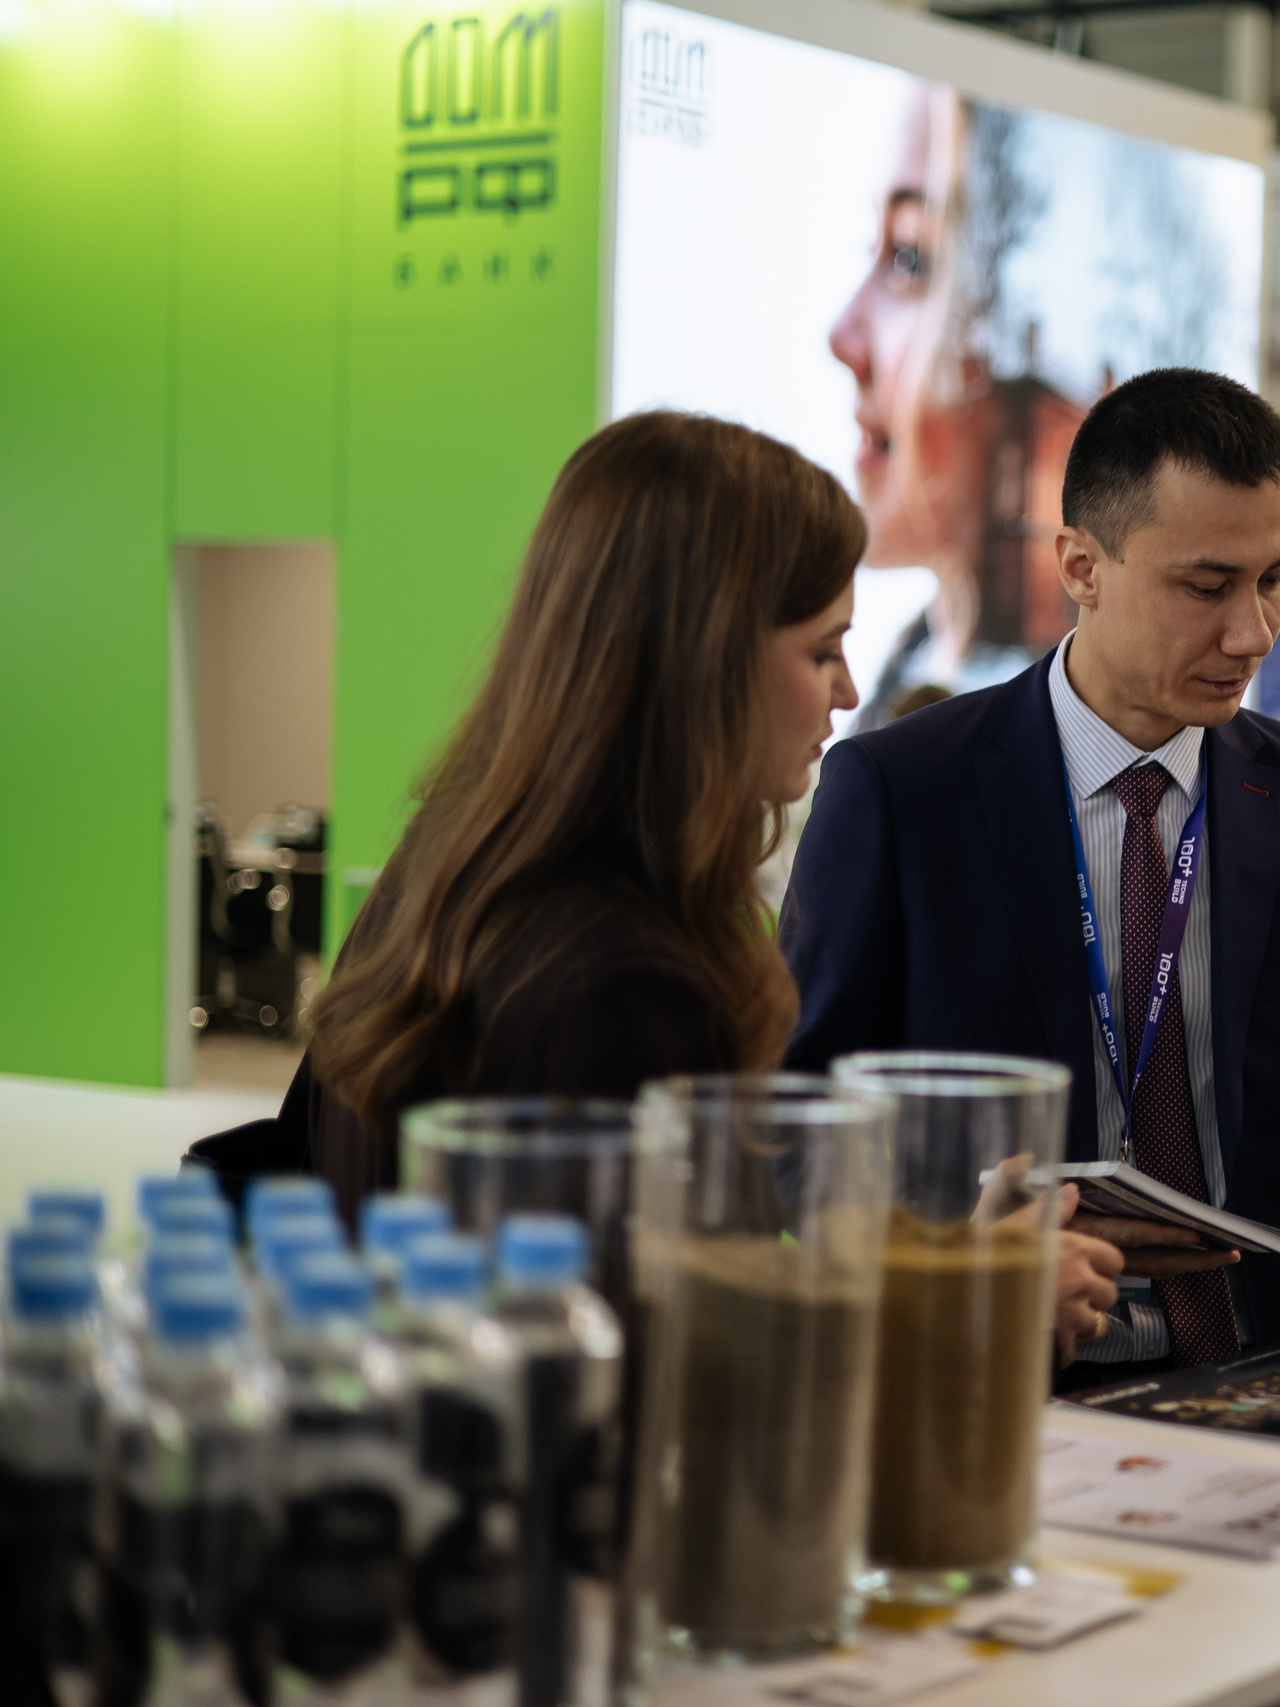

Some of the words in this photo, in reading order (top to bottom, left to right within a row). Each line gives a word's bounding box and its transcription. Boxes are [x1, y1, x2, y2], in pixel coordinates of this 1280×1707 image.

[1178, 836, 1196, 877] 100+
[1171, 878, 1182, 904] BUILD
[1178, 880, 1188, 905] TECHNO
[1157, 952, 1174, 996] 100+
[1149, 995, 1159, 1022] BUILD
